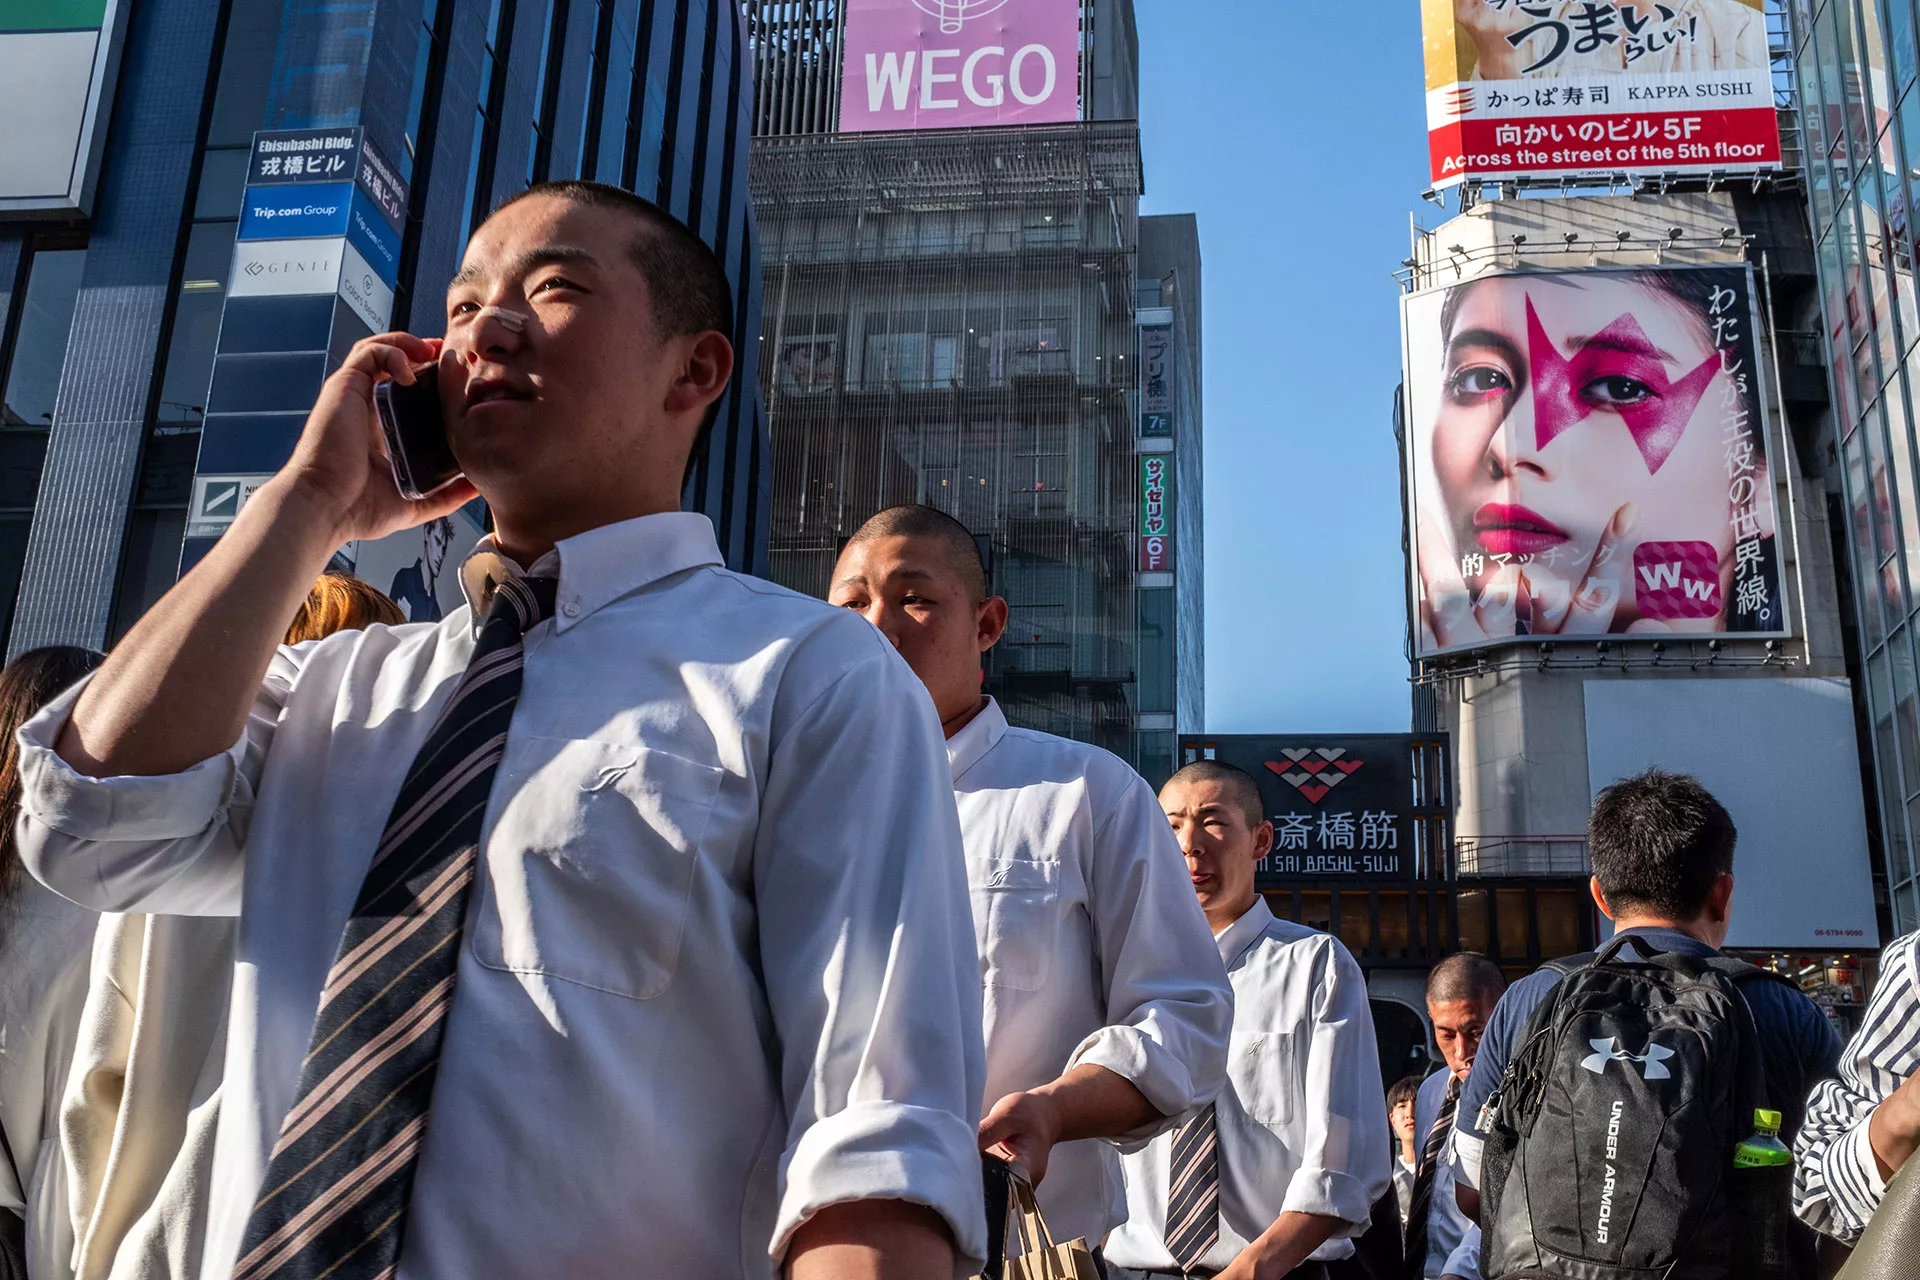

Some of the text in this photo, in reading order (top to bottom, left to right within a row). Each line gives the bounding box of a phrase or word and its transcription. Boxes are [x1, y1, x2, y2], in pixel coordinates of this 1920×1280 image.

[1506, 3, 1675, 73] うまい
[865, 44, 1056, 112] WEGO
[1488, 86, 1610, 108] かっぱ寿司
[1628, 82, 1753, 100] KAPPA SUSHI
[259, 136, 354, 152] Ebisubashi Bldg.
[261, 155, 346, 176] 戎橋ビル
[1441, 141, 1765, 173] Across the street of the 5th floor
[254, 205, 337, 219] Trip.com Group
[268, 260, 331, 273] GENIE
[1148, 415, 1167, 429] 7F
[1597, 1100, 1624, 1244] UNDER ARMOUR
